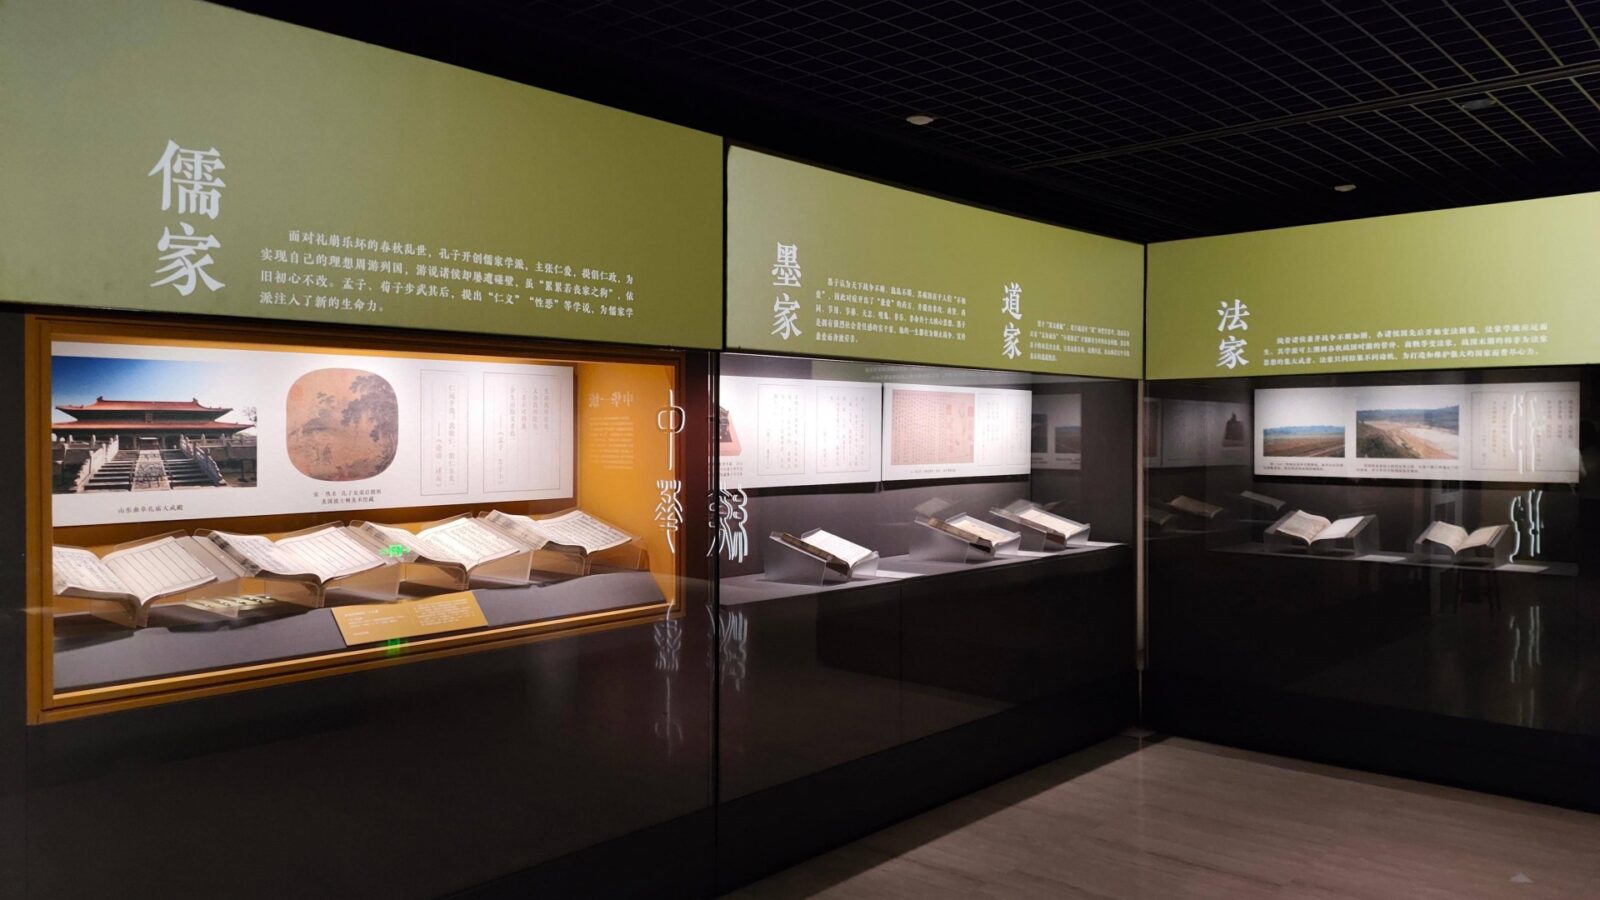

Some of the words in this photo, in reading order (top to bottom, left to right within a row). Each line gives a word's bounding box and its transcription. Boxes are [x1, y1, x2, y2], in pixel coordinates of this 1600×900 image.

[149, 140, 226, 297] 儒家
[259, 291, 384, 313] 派注入了新的生命力。
[771, 241, 803, 341] 墨家
[1001, 281, 1023, 360] 道家
[1216, 299, 1251, 370] 法家
